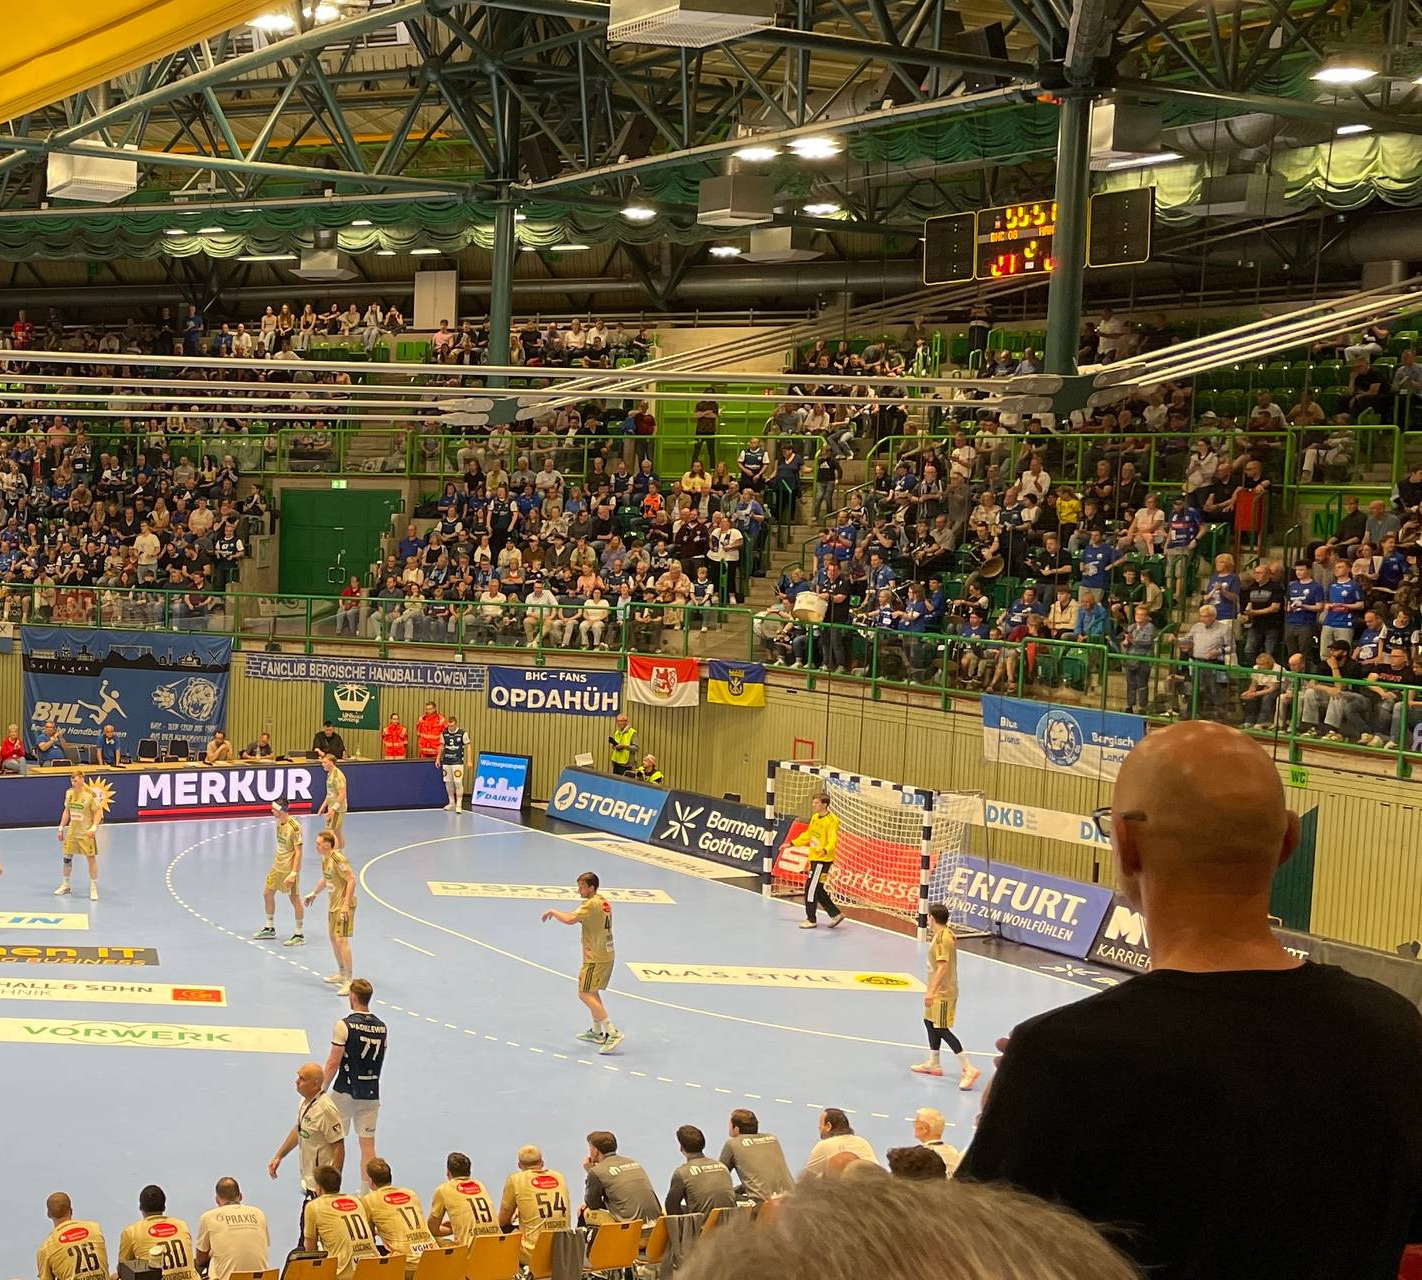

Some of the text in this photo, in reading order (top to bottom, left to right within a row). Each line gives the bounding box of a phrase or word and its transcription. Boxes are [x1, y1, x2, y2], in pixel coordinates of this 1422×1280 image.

[260, 660, 467, 686] FANCLUB BERGISCHE HANDBALL LÖWEN
[525, 671, 548, 681] BHC
[559, 672, 588, 683] FANS
[490, 686, 619, 711] OPDAHÜH
[31, 702, 83, 725] BHL
[1000, 716, 1019, 729] Blue
[1091, 732, 1134, 748] Bergisch
[138, 767, 313, 806] MERKUR
[485, 793, 518, 803] DAIKIN
[574, 792, 654, 826] STORCH
[986, 804, 1024, 828] DKB
[698, 831, 758, 862] Gothaer
[1002, 911, 1074, 941] WOHLFÜHLEN
[25, 956, 147, 967] BUSINESS
[97, 946, 146, 959] IT
[86, 984, 154, 994] SOHN
[746, 972, 842, 984] STYLE
[22, 1024, 233, 1044] VORWERK
[359, 1035, 382, 1061] 77
[466, 1197, 493, 1224] 19
[535, 1191, 567, 1219] 54
[225, 1214, 258, 1225] PRAXIS
[341, 1213, 369, 1241] 10
[396, 1206, 421, 1230] 17
[67, 1242, 100, 1274] 26
[411, 1244, 428, 1252] VGH
